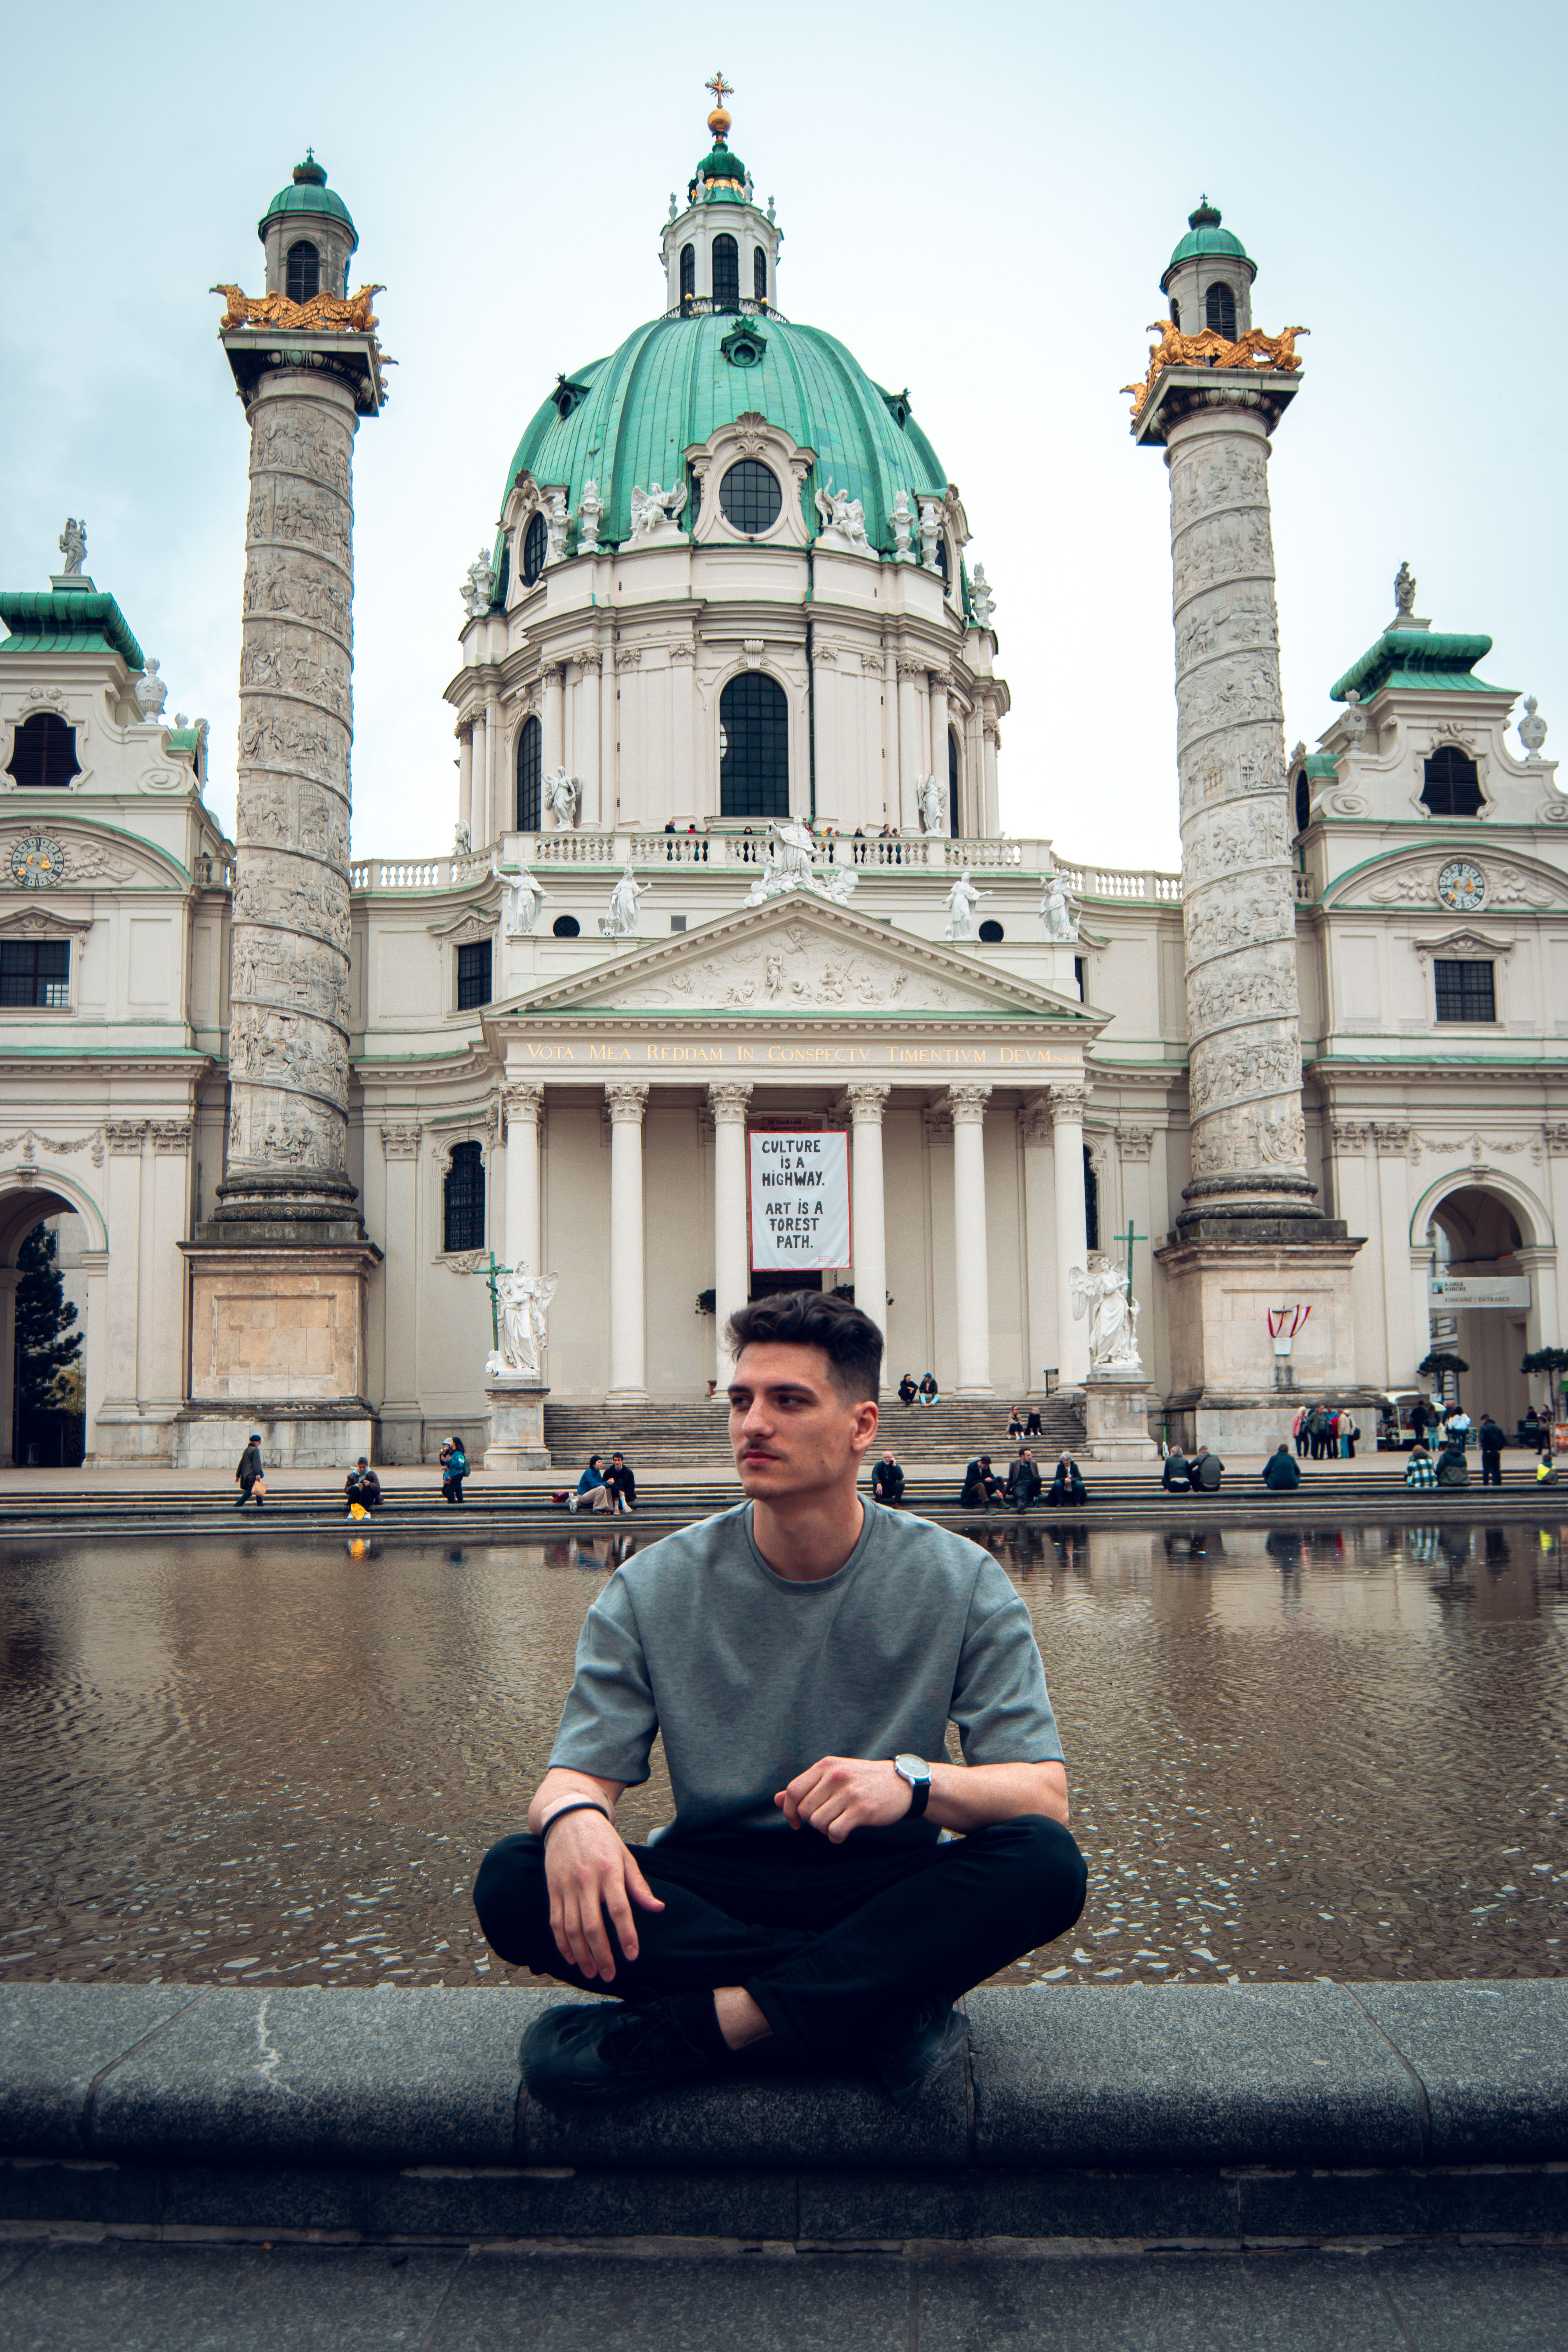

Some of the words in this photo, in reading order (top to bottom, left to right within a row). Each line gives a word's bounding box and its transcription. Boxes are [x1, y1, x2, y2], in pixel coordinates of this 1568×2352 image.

[526, 1044, 575, 1060] VOTA
[590, 1044, 632, 1060] MEA
[647, 1045, 722, 1061] REDDAM
[737, 1045, 753, 1060] IN
[768, 1046, 871, 1062] CONSPECTV
[885, 1047, 987, 1062] TIMENTIVM
[762, 1140, 820, 1153] CULTURE
[796, 1156, 805, 1168] A
[765, 1202, 791, 1215] ART
[814, 1201, 823, 1214] A
[769, 1217, 820, 1231] FOREST
[777, 1235, 813, 1249] PATH.
